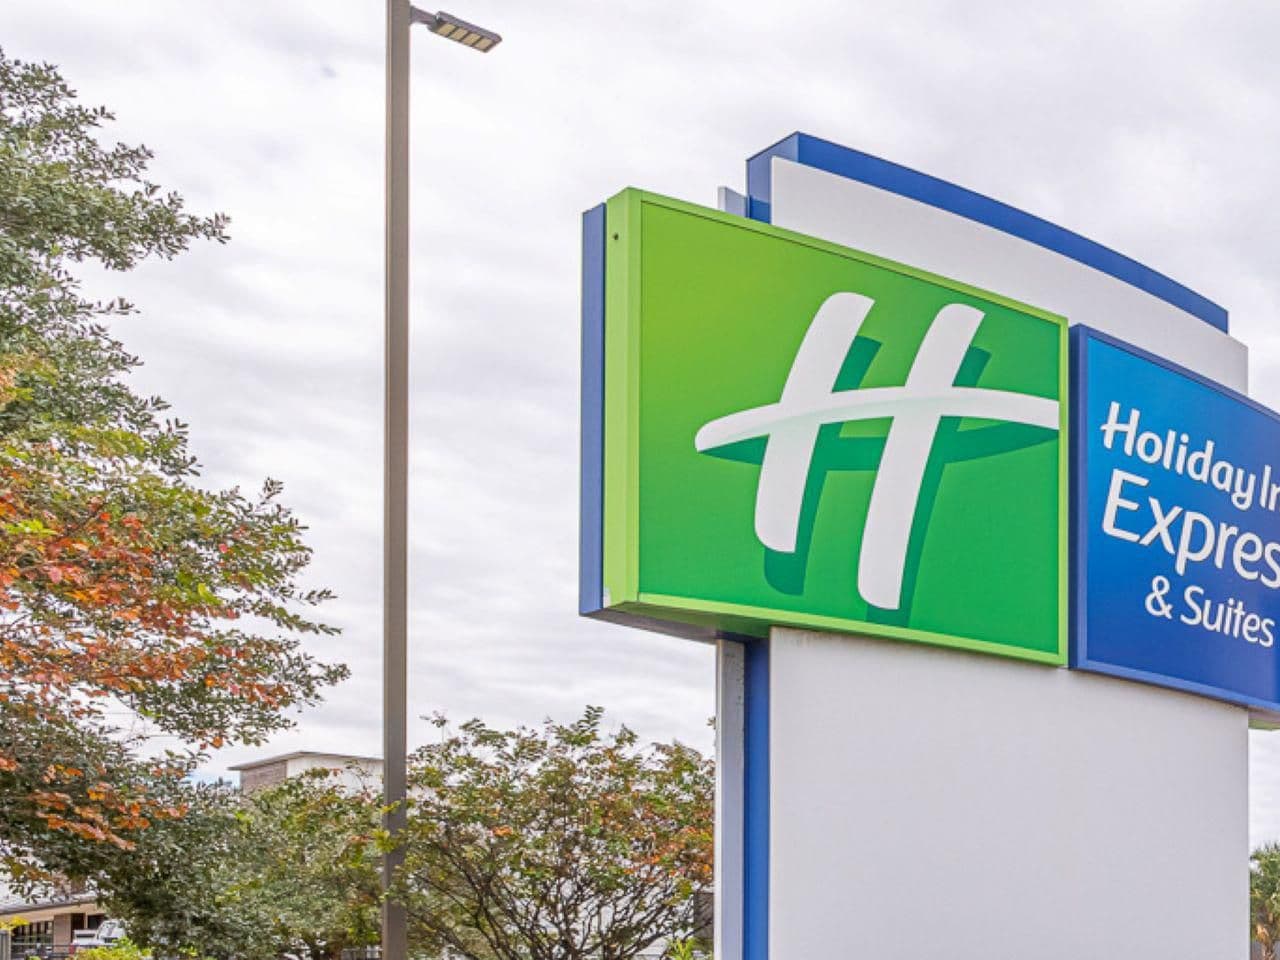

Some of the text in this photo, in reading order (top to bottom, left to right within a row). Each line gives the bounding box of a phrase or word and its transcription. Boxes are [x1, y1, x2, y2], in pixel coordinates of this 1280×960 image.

[1101, 401, 1255, 510] Holiday
[1145, 576, 1275, 647] & Suites
